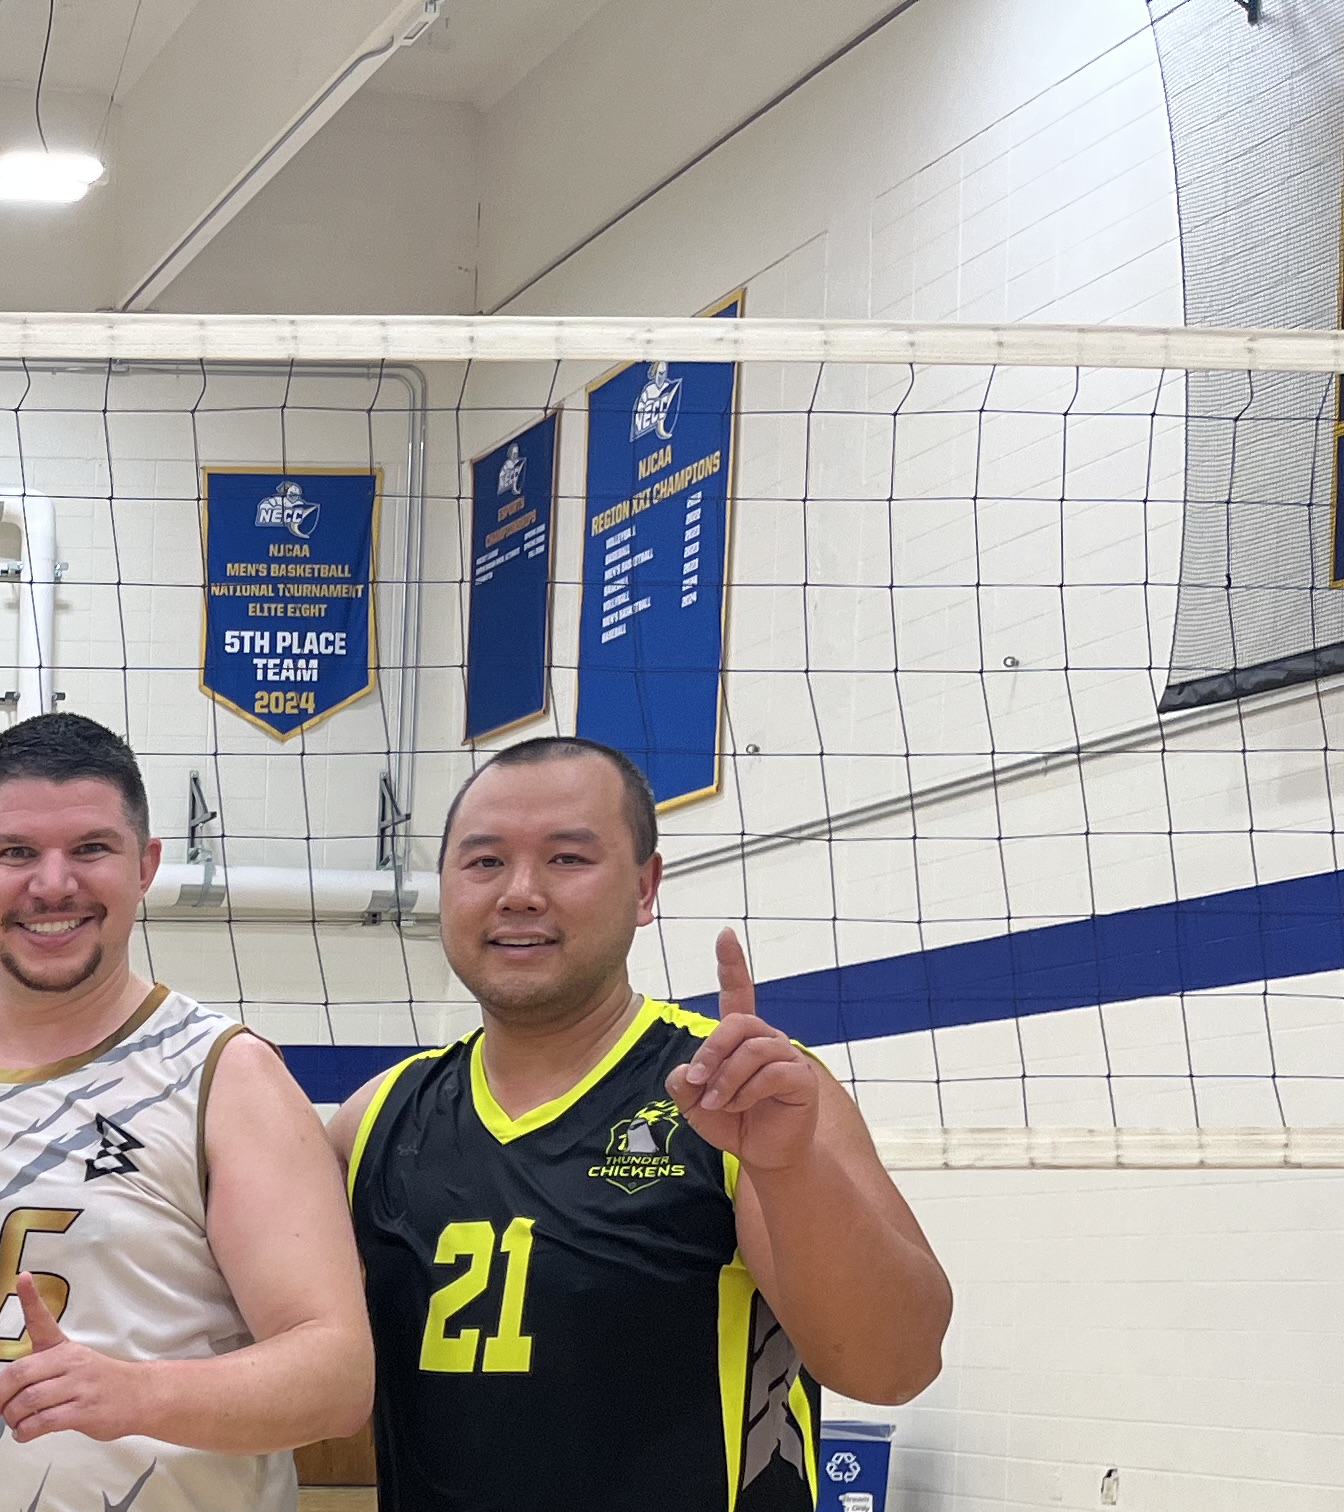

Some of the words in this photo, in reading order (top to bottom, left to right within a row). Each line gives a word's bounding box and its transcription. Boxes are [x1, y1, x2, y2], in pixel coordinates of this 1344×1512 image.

[638, 444, 672, 480] NJCAA
[592, 499, 630, 537] REGION
[632, 488, 651, 516] XXI
[653, 450, 721, 504] CHAMPIONS
[259, 508, 302, 523] NECC
[269, 544, 309, 557] NJCAA
[227, 563, 267, 576] MEN'S
[271, 564, 351, 577] BASKETBALL
[211, 583, 274, 596] NATIONAL
[277, 584, 364, 598] TOURNAMENT
[249, 603, 284, 616] ELITE
[287, 604, 327, 617] EIGHT
[225, 631, 269, 653] 5TH
[277, 632, 346, 654] PLACE
[253, 658, 318, 681] TEAM
[253, 691, 315, 714] 2024
[606, 1156, 670, 1165] THUNDER
[588, 1164, 685, 1178] CHICKENS
[419, 1217, 536, 1372] 21
